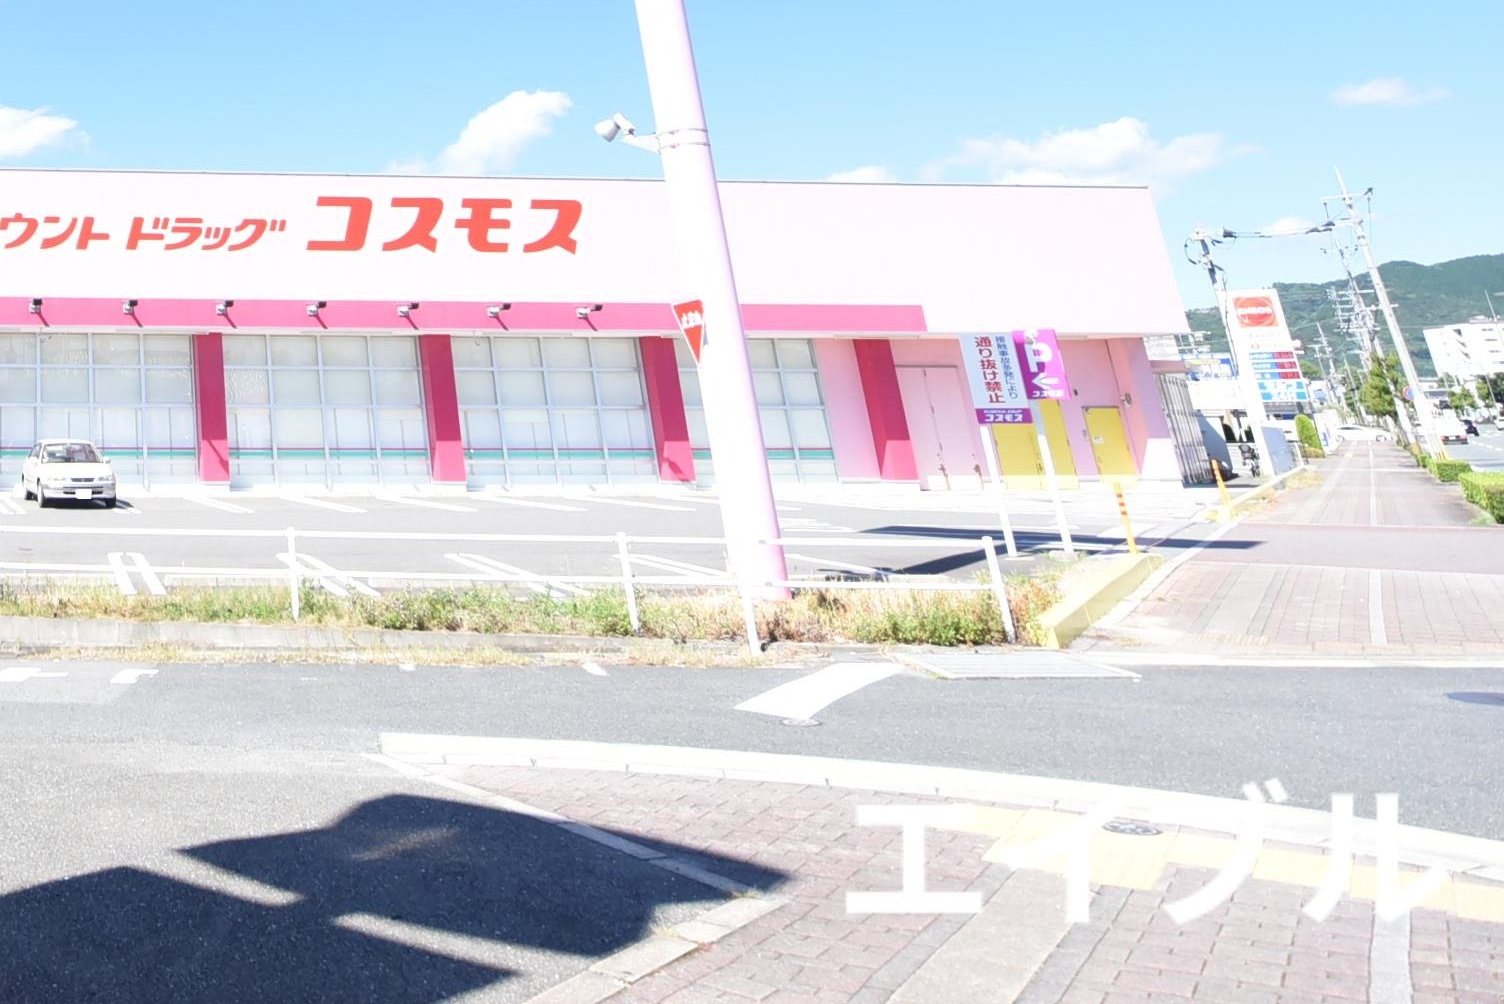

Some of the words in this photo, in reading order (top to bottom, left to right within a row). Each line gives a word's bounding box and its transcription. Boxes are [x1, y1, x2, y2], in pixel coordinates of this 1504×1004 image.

[126, 216, 287, 251] ドラッグ
[306, 195, 583, 255] コスモス
[974, 336, 1005, 403] 通り抜け禁止
[1024, 342, 1052, 373] P
[985, 414, 1023, 422] コスモス
